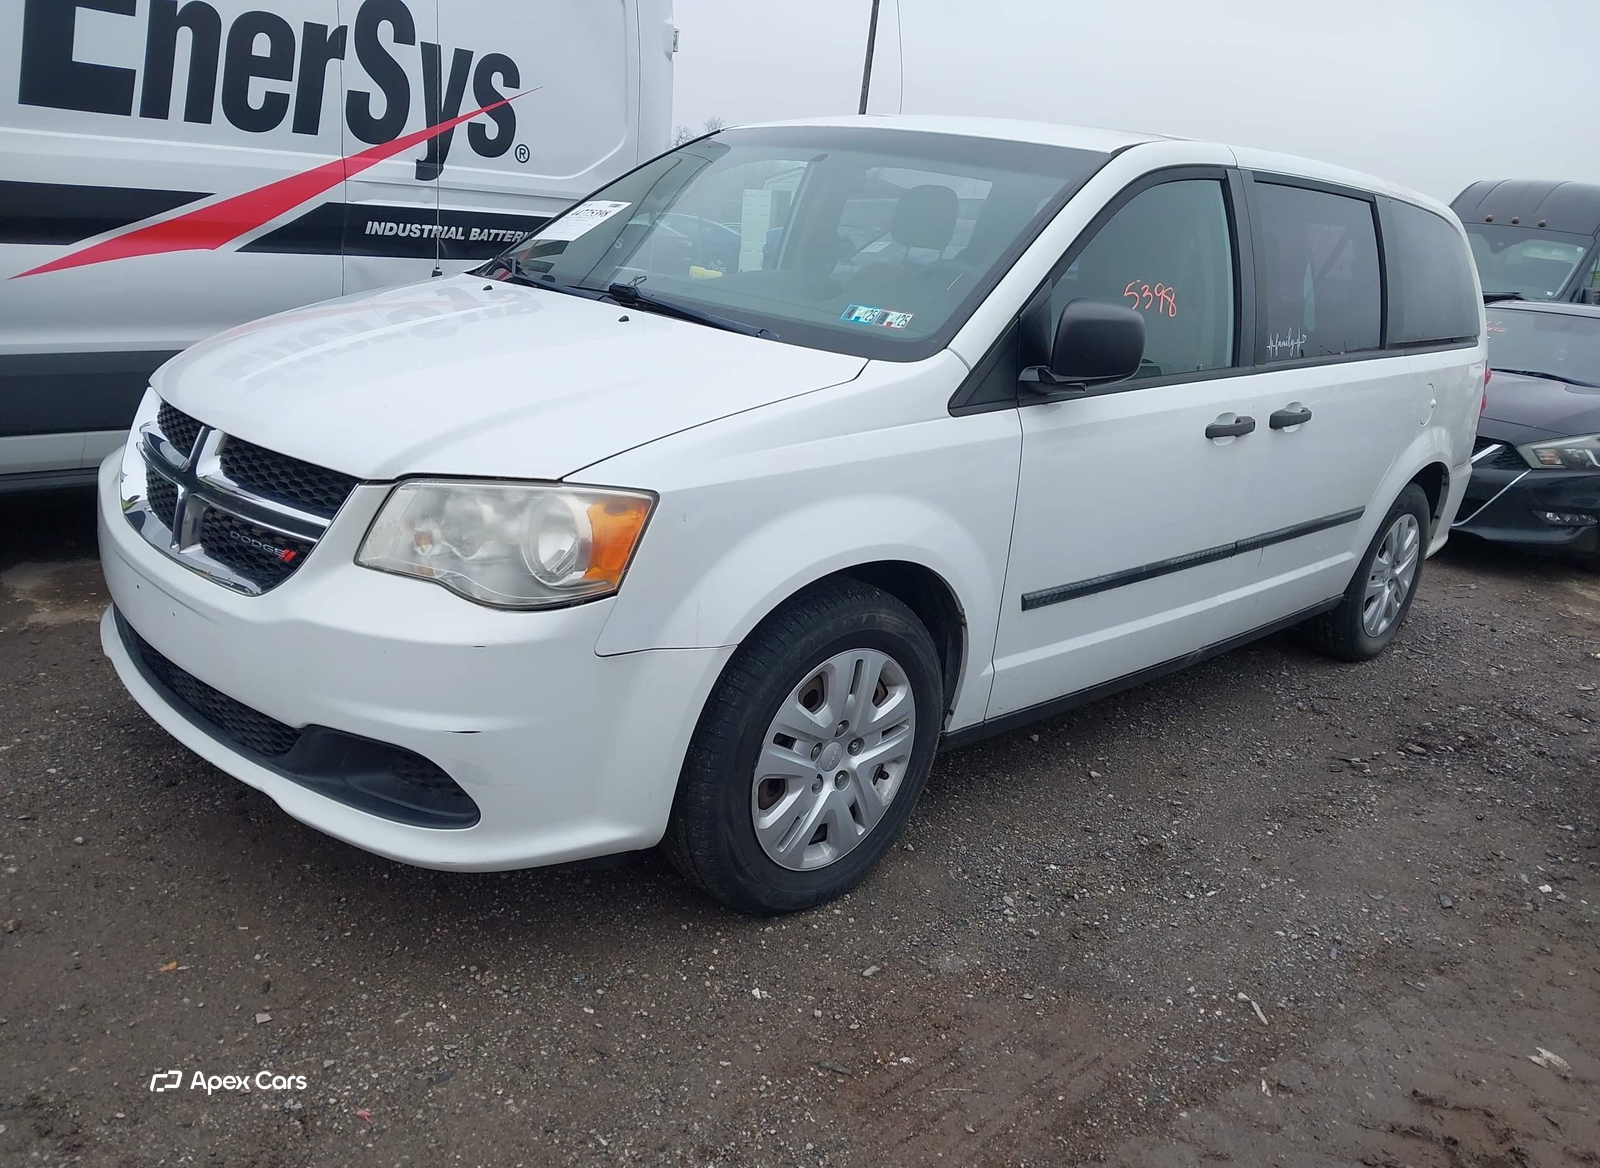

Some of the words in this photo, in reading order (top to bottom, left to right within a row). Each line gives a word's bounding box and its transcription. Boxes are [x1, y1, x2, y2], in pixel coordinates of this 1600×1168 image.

[365, 220, 465, 241] INDUSTRIAL
[468, 227, 532, 243] BATTERI
[1123, 280, 1177, 317] 5398
[230, 530, 286, 558] DODGE
